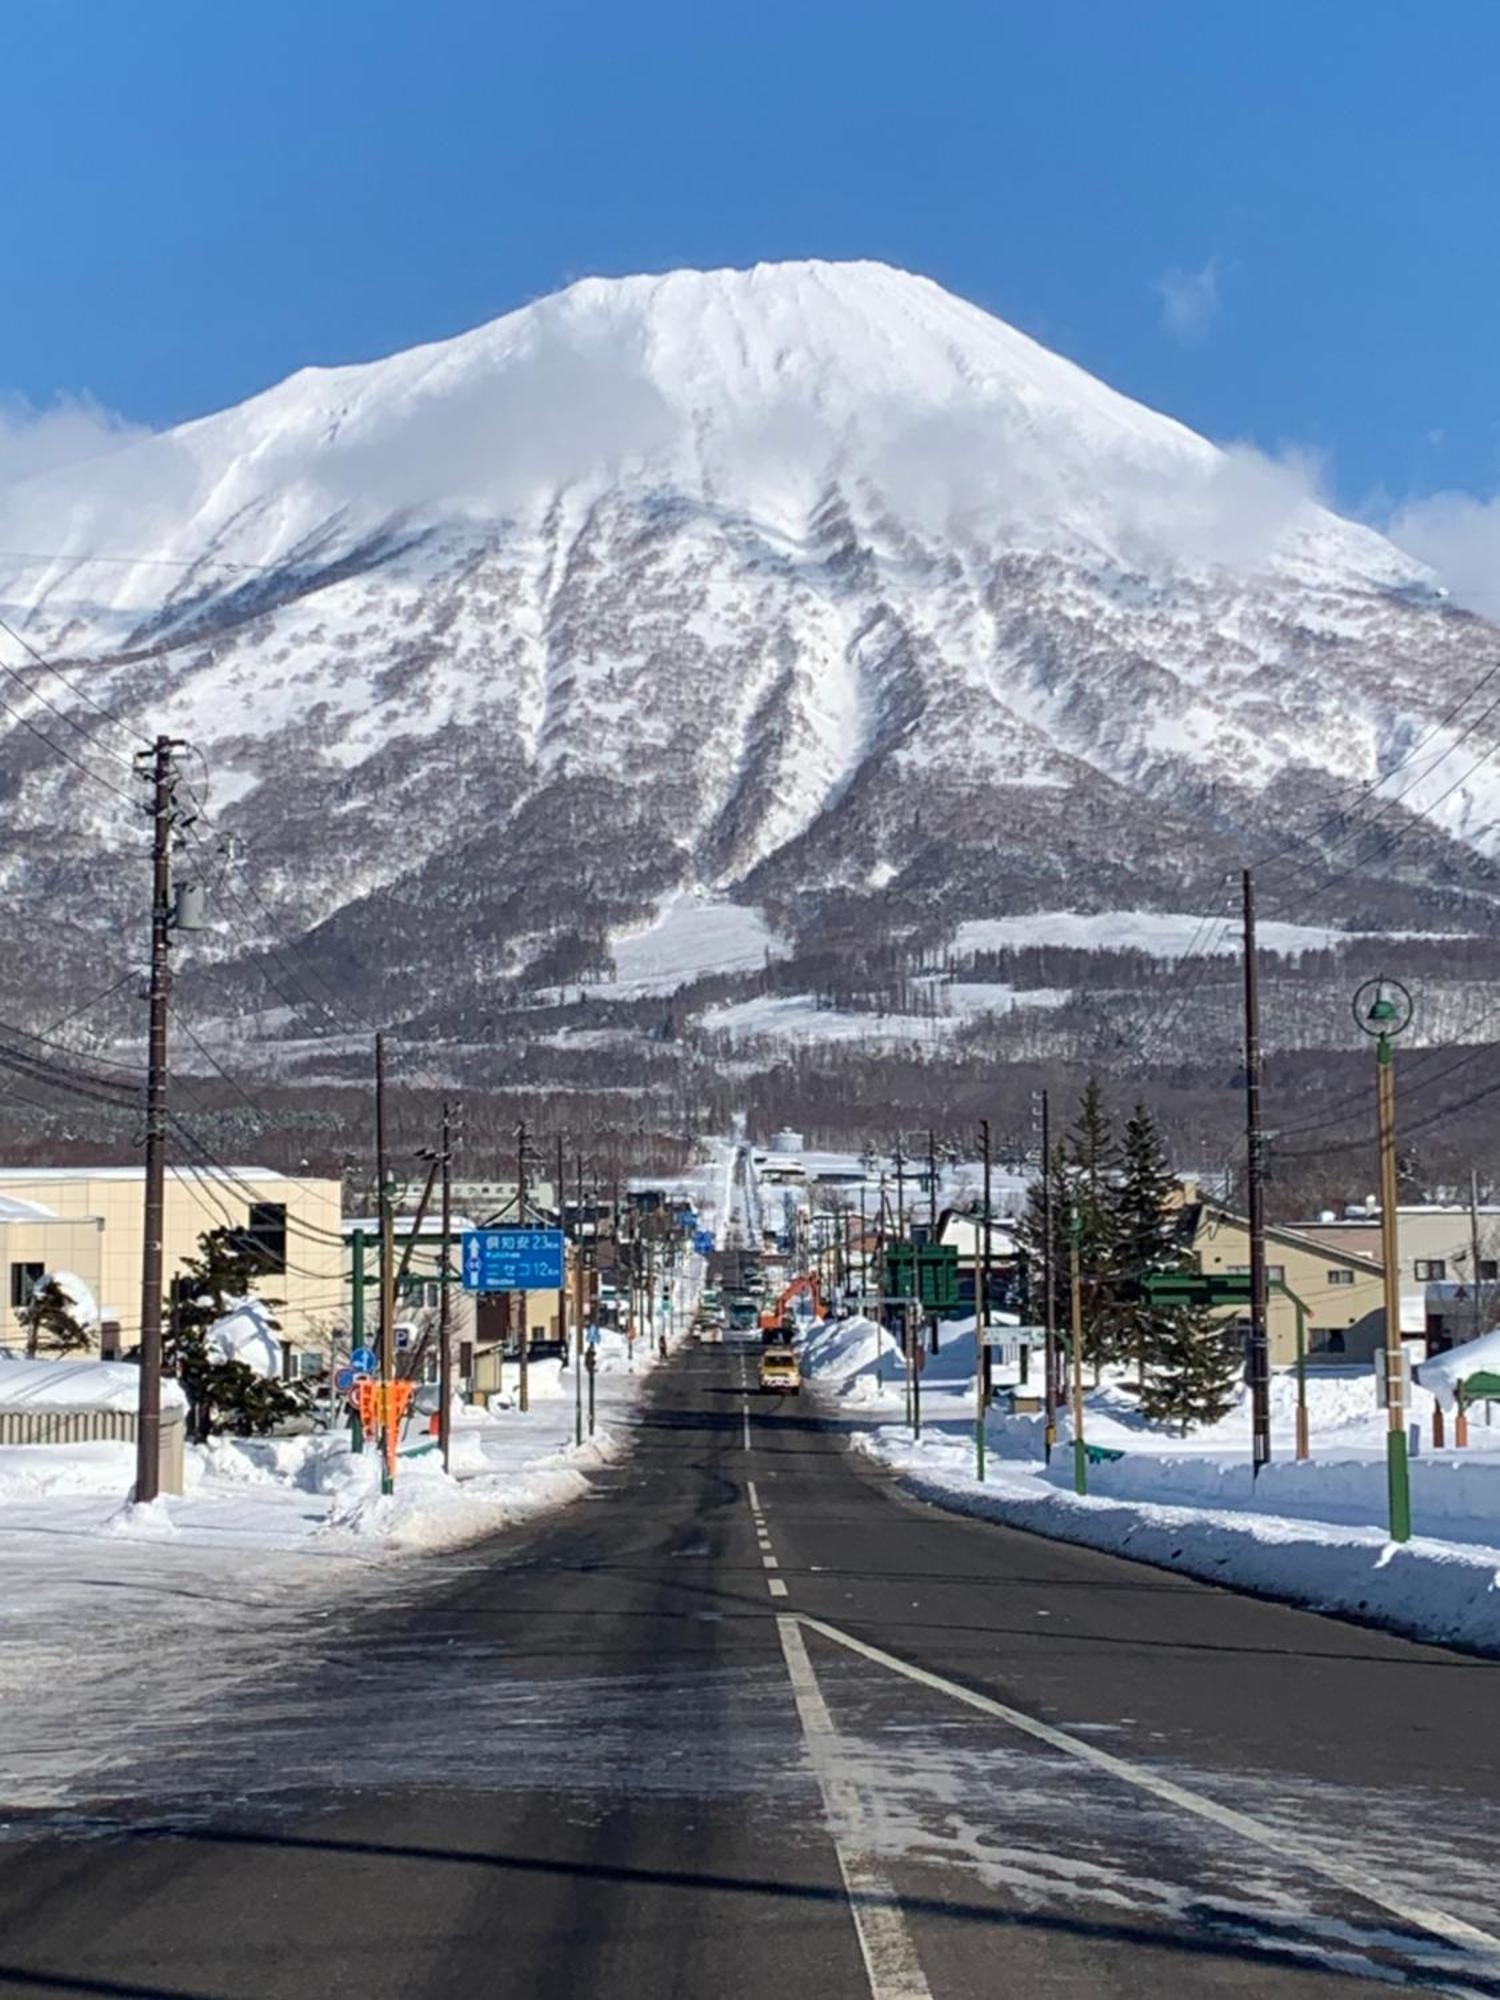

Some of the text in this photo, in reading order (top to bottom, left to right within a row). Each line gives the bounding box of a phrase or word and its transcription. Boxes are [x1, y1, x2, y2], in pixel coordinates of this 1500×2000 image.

[487, 1263, 531, 1276] ニセコ
[395, 1330, 407, 1346] P
